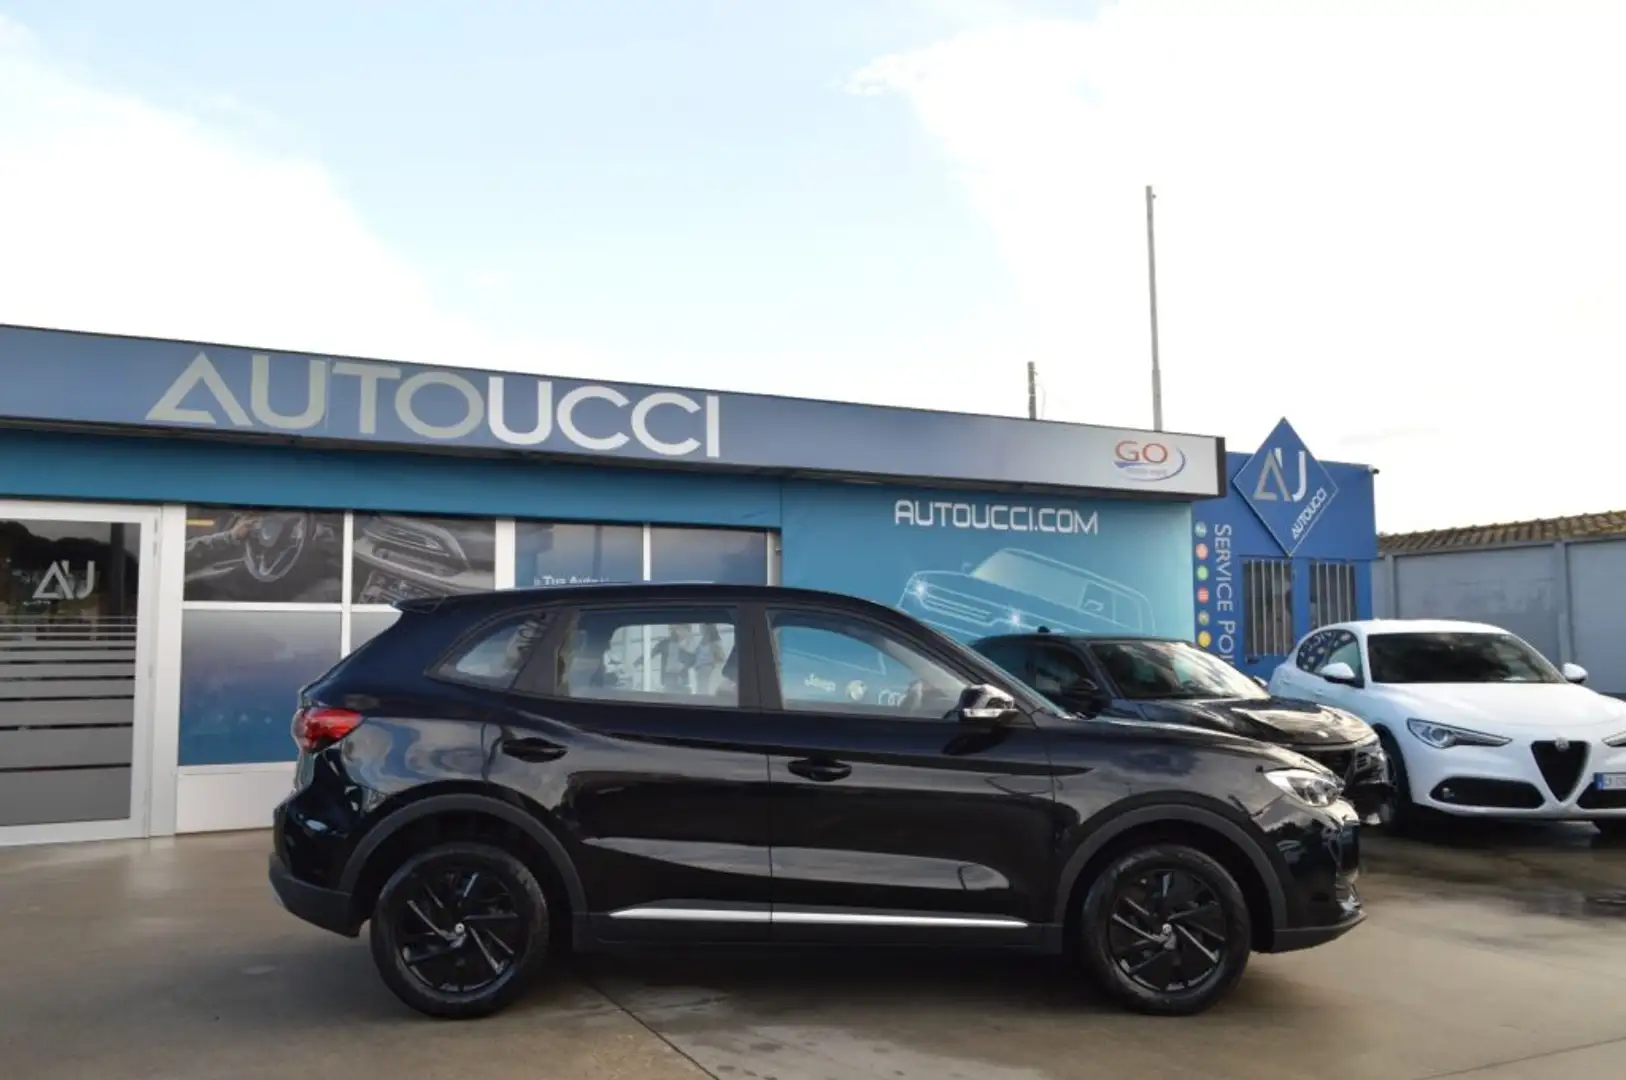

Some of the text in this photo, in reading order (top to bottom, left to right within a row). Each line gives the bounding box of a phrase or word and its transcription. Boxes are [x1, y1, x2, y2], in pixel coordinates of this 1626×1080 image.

[145, 352, 719, 457] AUTOUCCI
[1115, 440, 1168, 464] GO
[895, 500, 1098, 535] AUTOUCCI.COM
[1214, 524, 1236, 665] SERVICE POI
